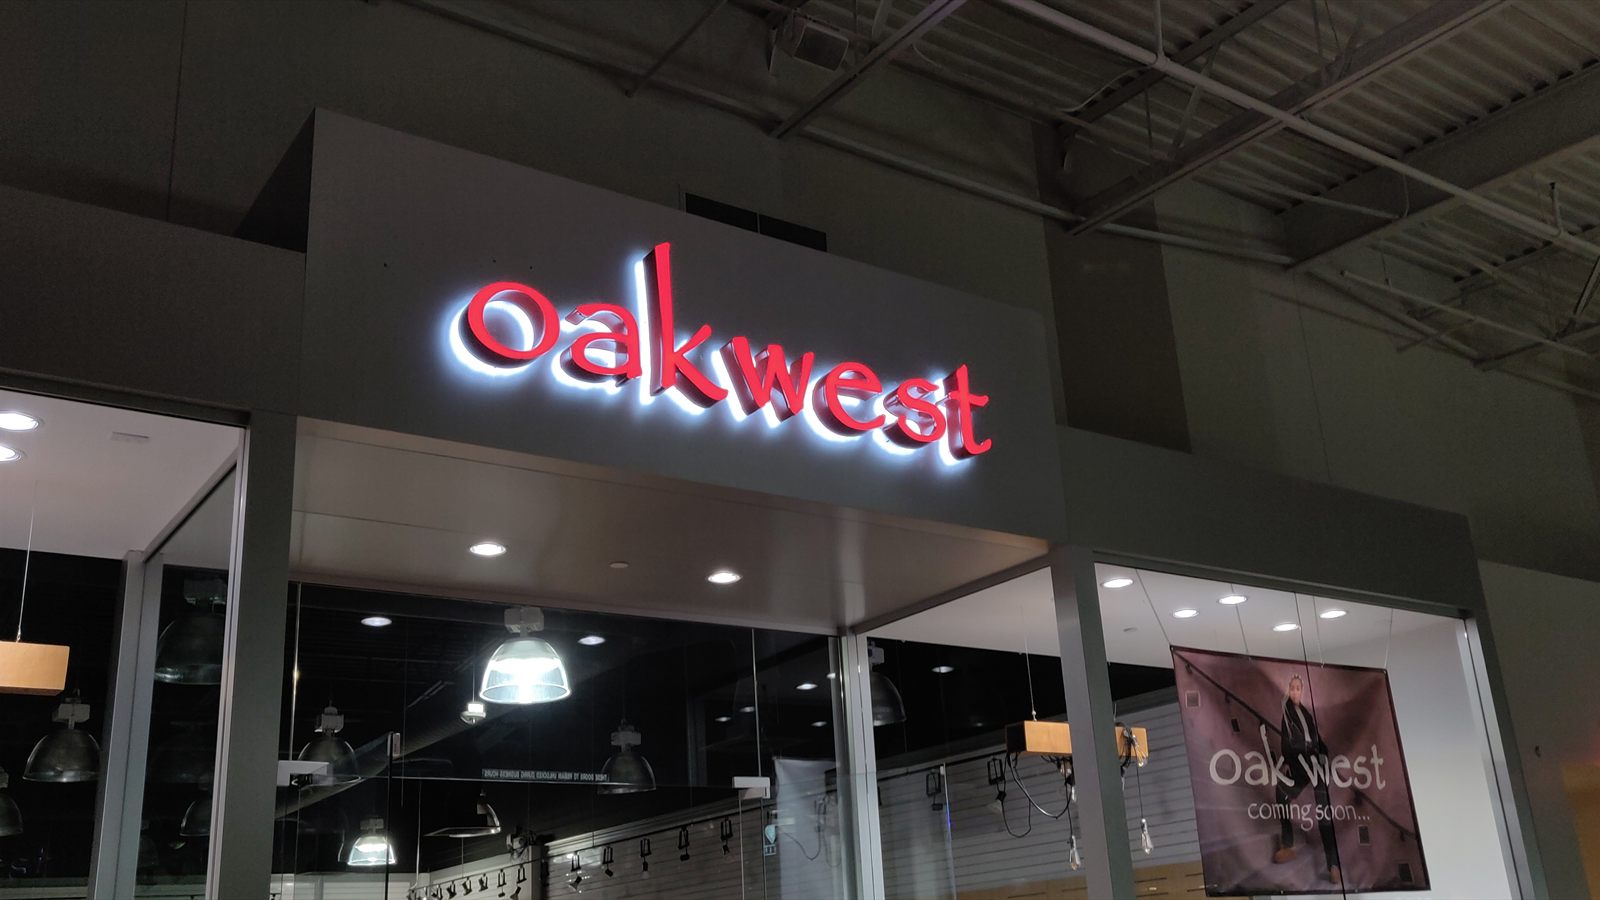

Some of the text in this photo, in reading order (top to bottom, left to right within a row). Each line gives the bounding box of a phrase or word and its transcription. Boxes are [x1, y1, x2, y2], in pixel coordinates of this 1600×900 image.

[1210, 724, 1386, 789] oak west
[1247, 802, 1314, 832] coming
